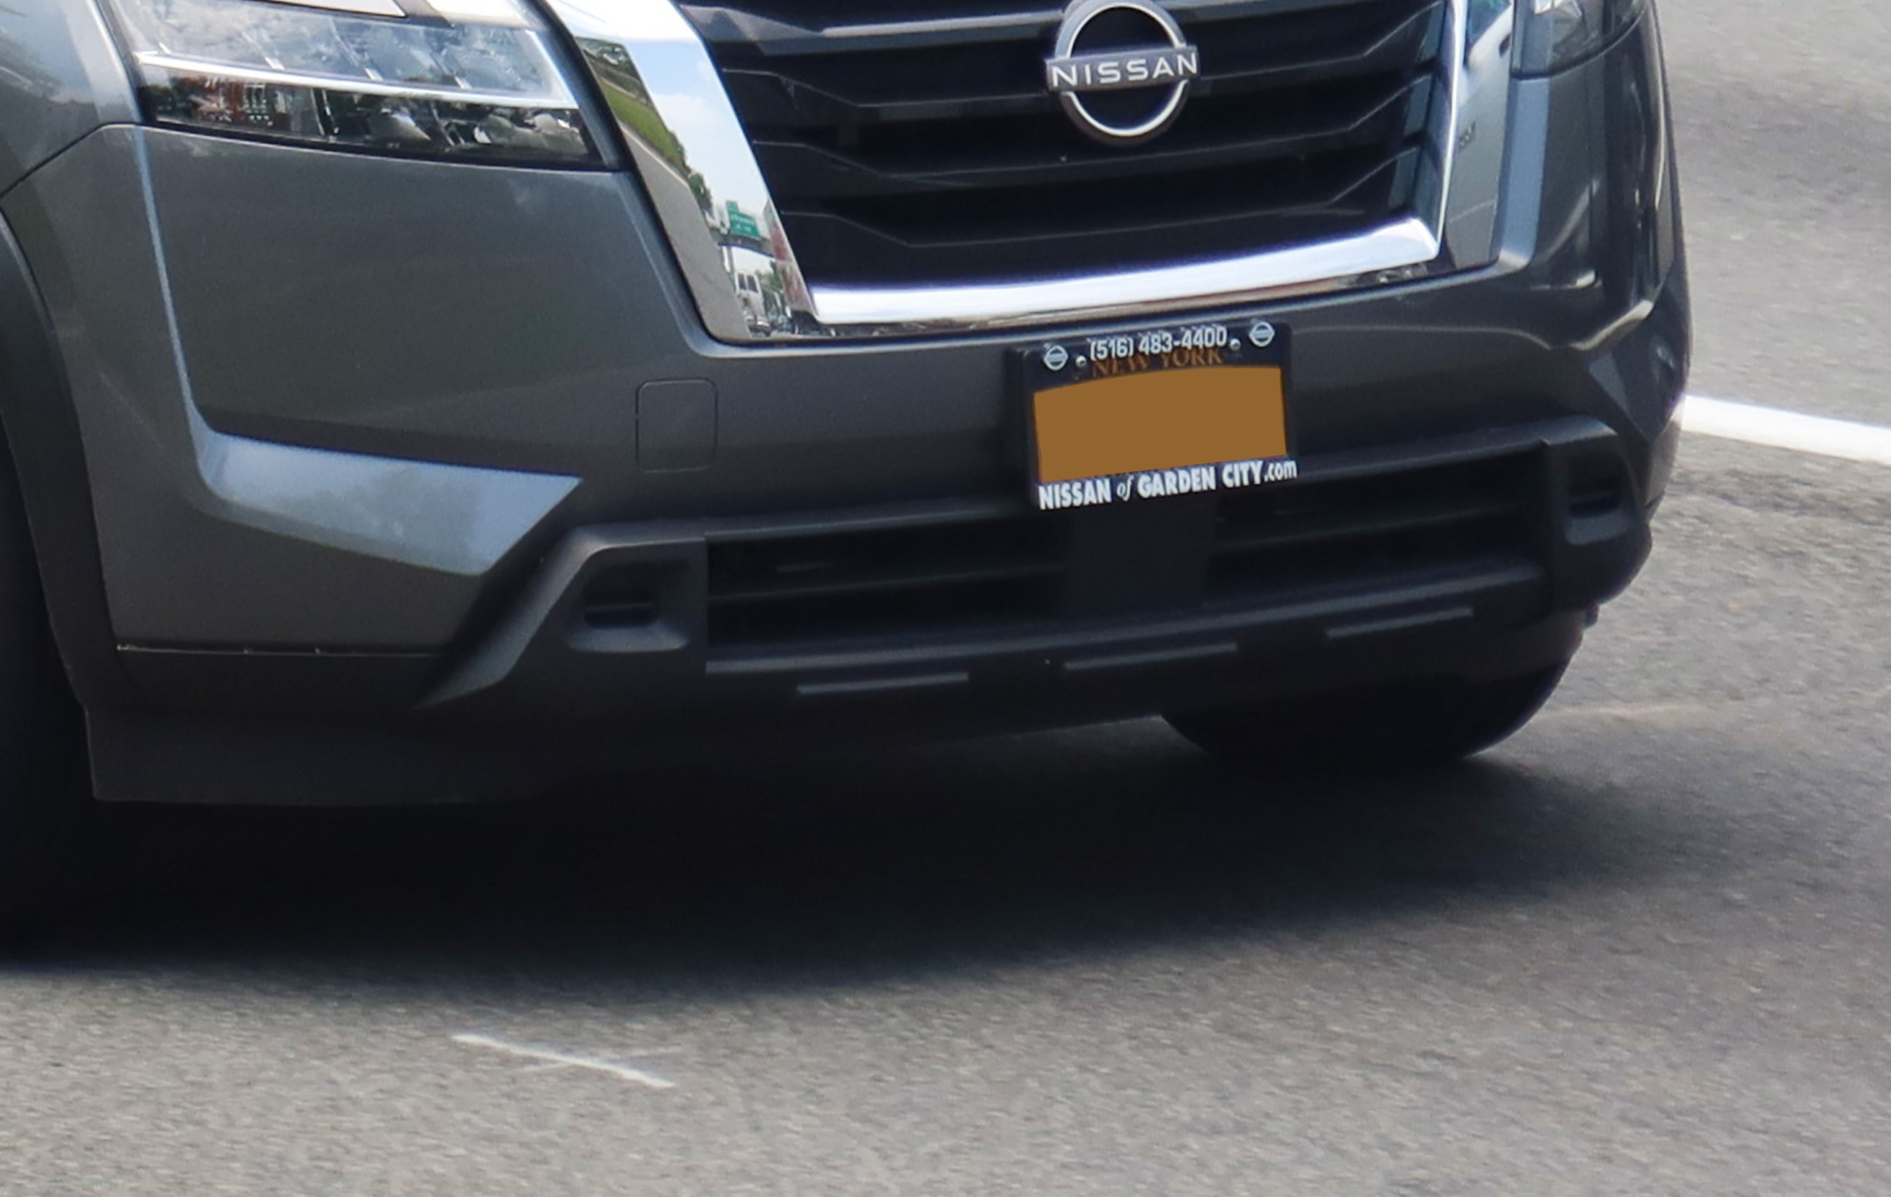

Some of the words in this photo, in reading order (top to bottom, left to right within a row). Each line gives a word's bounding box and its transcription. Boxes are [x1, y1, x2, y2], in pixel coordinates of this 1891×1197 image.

[1051, 52, 1198, 88] NISSAN
[1090, 337, 1134, 361] (516)
[1139, 326, 1228, 355] 483-4400
[1092, 354, 1150, 378] NEW
[1162, 347, 1224, 368] YORK
[1038, 478, 1112, 510] NISSAN
[1116, 473, 1135, 501] of
[1137, 465, 1217, 499] GARDEN
